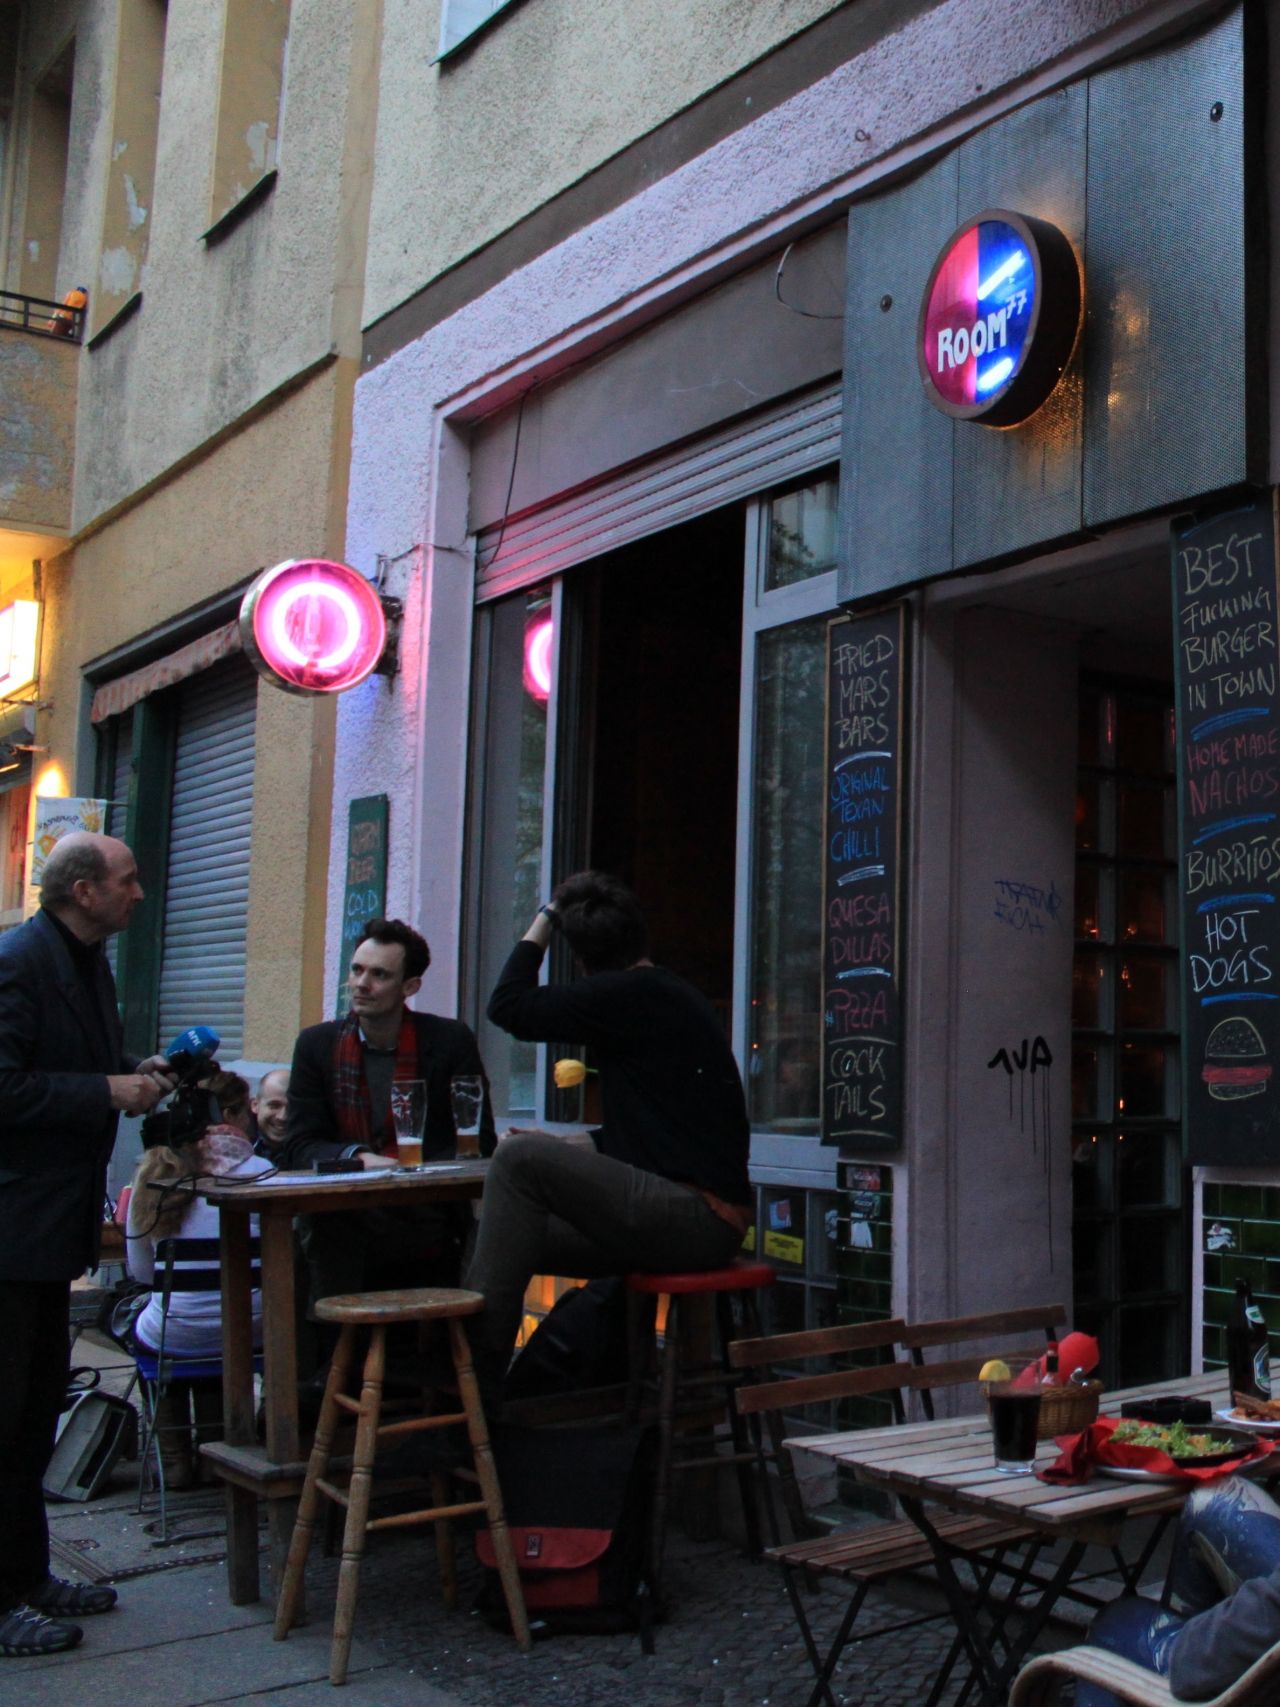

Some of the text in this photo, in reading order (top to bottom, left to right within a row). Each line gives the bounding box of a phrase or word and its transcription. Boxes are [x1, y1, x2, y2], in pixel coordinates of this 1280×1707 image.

[1180, 533, 1262, 595] BEST
[833, 634, 894, 676] FRIED
[1180, 621, 1275, 673] BURGER
[840, 669, 891, 718] MARS
[1188, 664, 1276, 711] IN TOWN
[835, 712, 890, 749] BARS
[1189, 766, 1279, 816] NACHOS
[831, 825, 880, 862] CHILLI
[828, 893, 890, 928] QUESA
[1205, 910, 1260, 953] HOT
[830, 932, 892, 965] DILLAS
[1189, 945, 1272, 992] DOGS
[830, 1046, 886, 1081] COCK
[826, 1081, 886, 1121] TAILS
